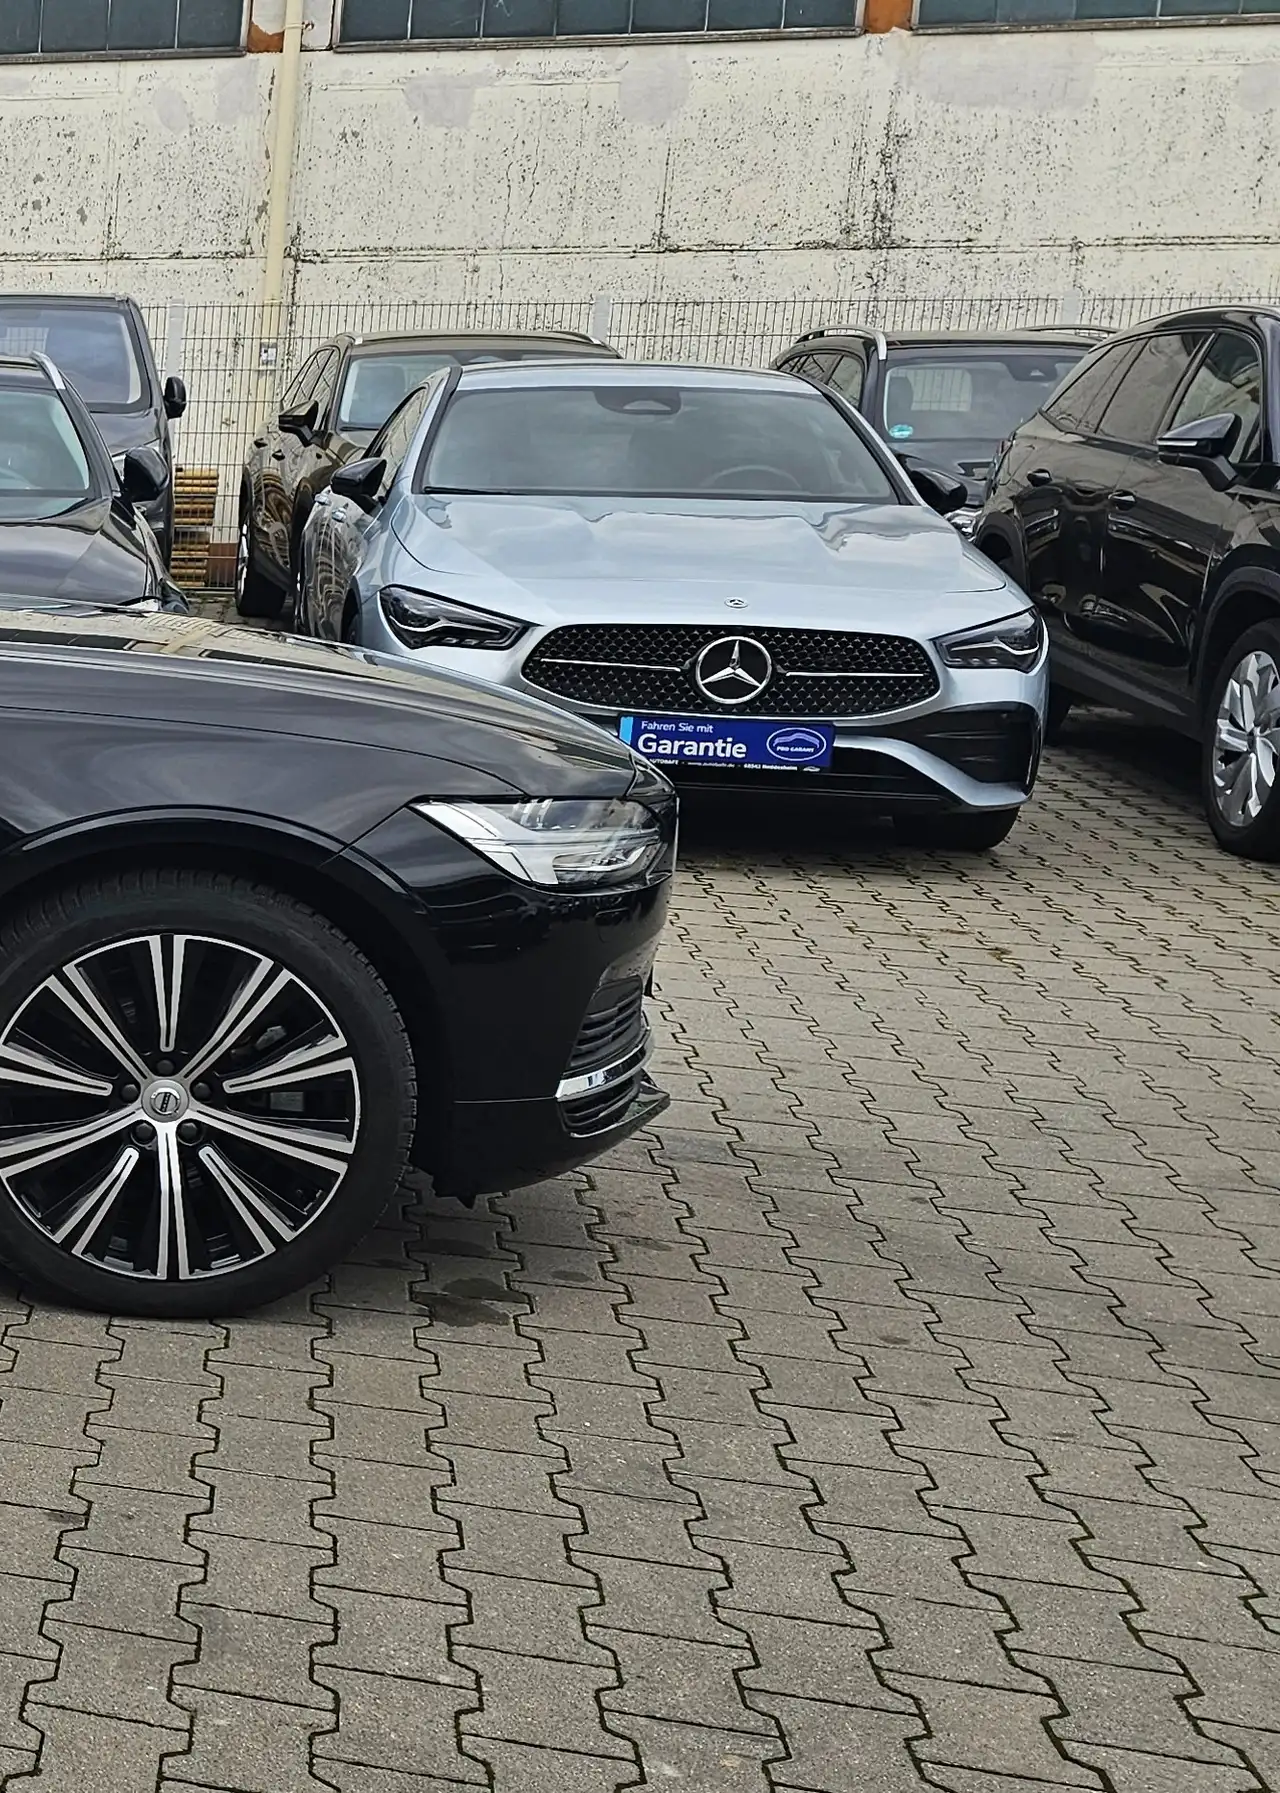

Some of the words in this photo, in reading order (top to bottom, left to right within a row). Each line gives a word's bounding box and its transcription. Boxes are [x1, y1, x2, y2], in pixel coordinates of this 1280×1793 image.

[641, 721, 676, 731] Fahren
[678, 722, 694, 732] Sie
[696, 724, 714, 733] mit
[637, 733, 747, 758] Garantie
